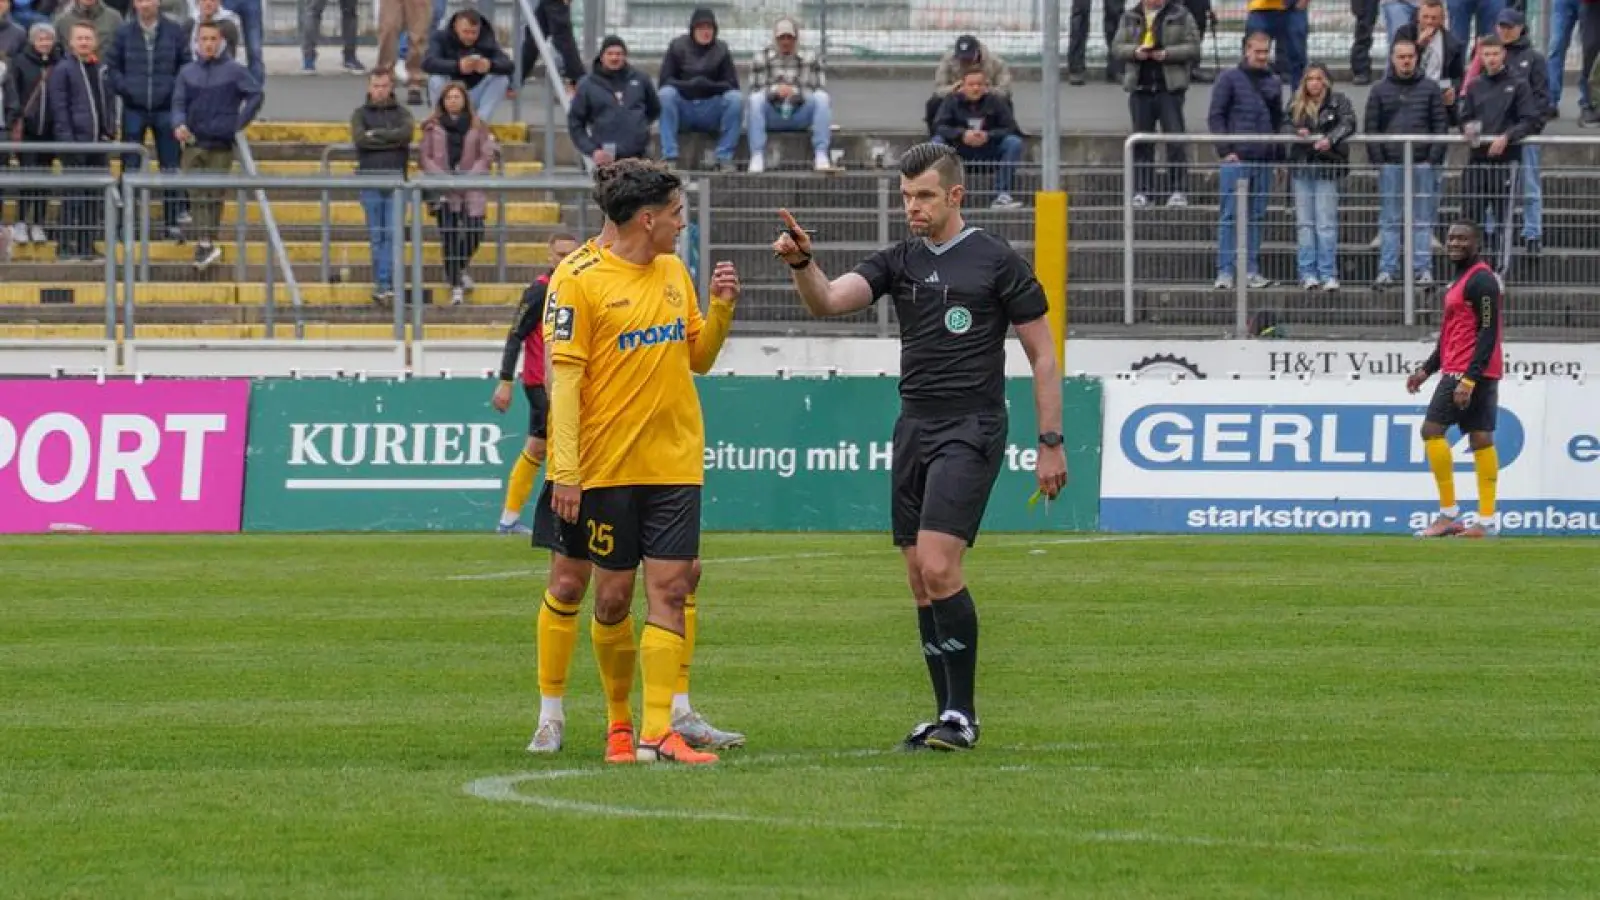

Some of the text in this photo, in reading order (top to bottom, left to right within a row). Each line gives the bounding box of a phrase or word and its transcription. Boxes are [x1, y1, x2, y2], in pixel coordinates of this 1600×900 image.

[618, 317, 686, 351] maxit
[1268, 352, 1338, 375] H&T
[0, 412, 226, 502] ORT
[287, 423, 502, 465] KURIER
[703, 440, 796, 477] eitung
[806, 440, 860, 471] mit
[1186, 505, 1371, 529] starkstrom
[587, 519, 614, 556] 25
